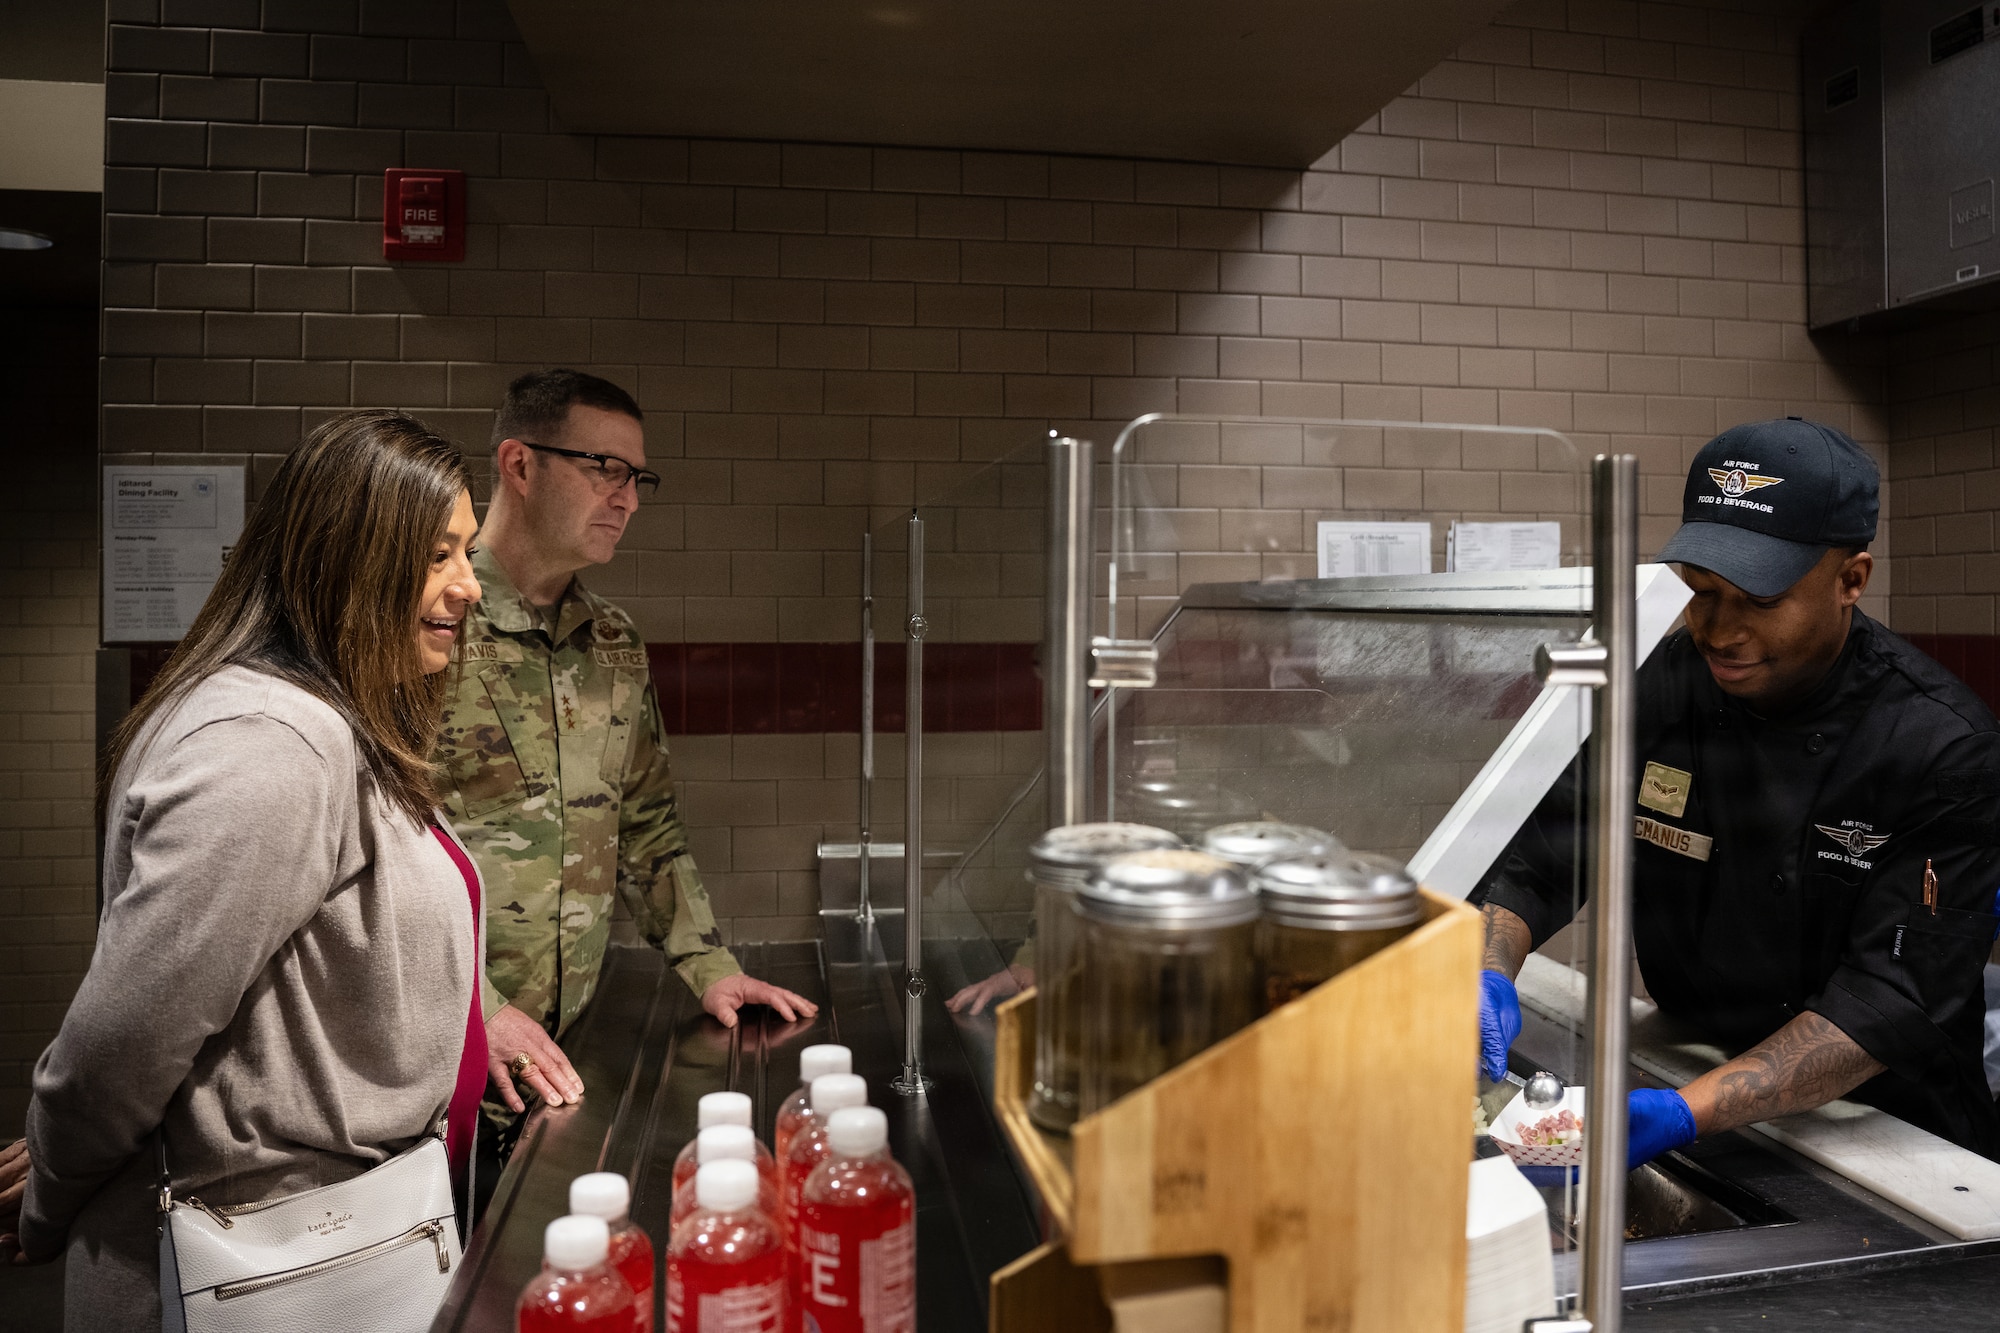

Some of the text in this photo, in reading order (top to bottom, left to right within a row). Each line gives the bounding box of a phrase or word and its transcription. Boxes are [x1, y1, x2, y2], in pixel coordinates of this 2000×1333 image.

[405, 209, 438, 221] FIRE
[1735, 461, 1760, 470] FORCE
[118, 489, 178, 498] Dining Facility
[1698, 496, 1774, 514] FOOD & BEVERAGE
[464, 644, 498, 659] AVIS
[1841, 819, 1854, 827] AIR
[1634, 820, 1691, 852] CMANUS
[1818, 851, 1842, 860] FOOD
[308, 1213, 354, 1233] kate spade
